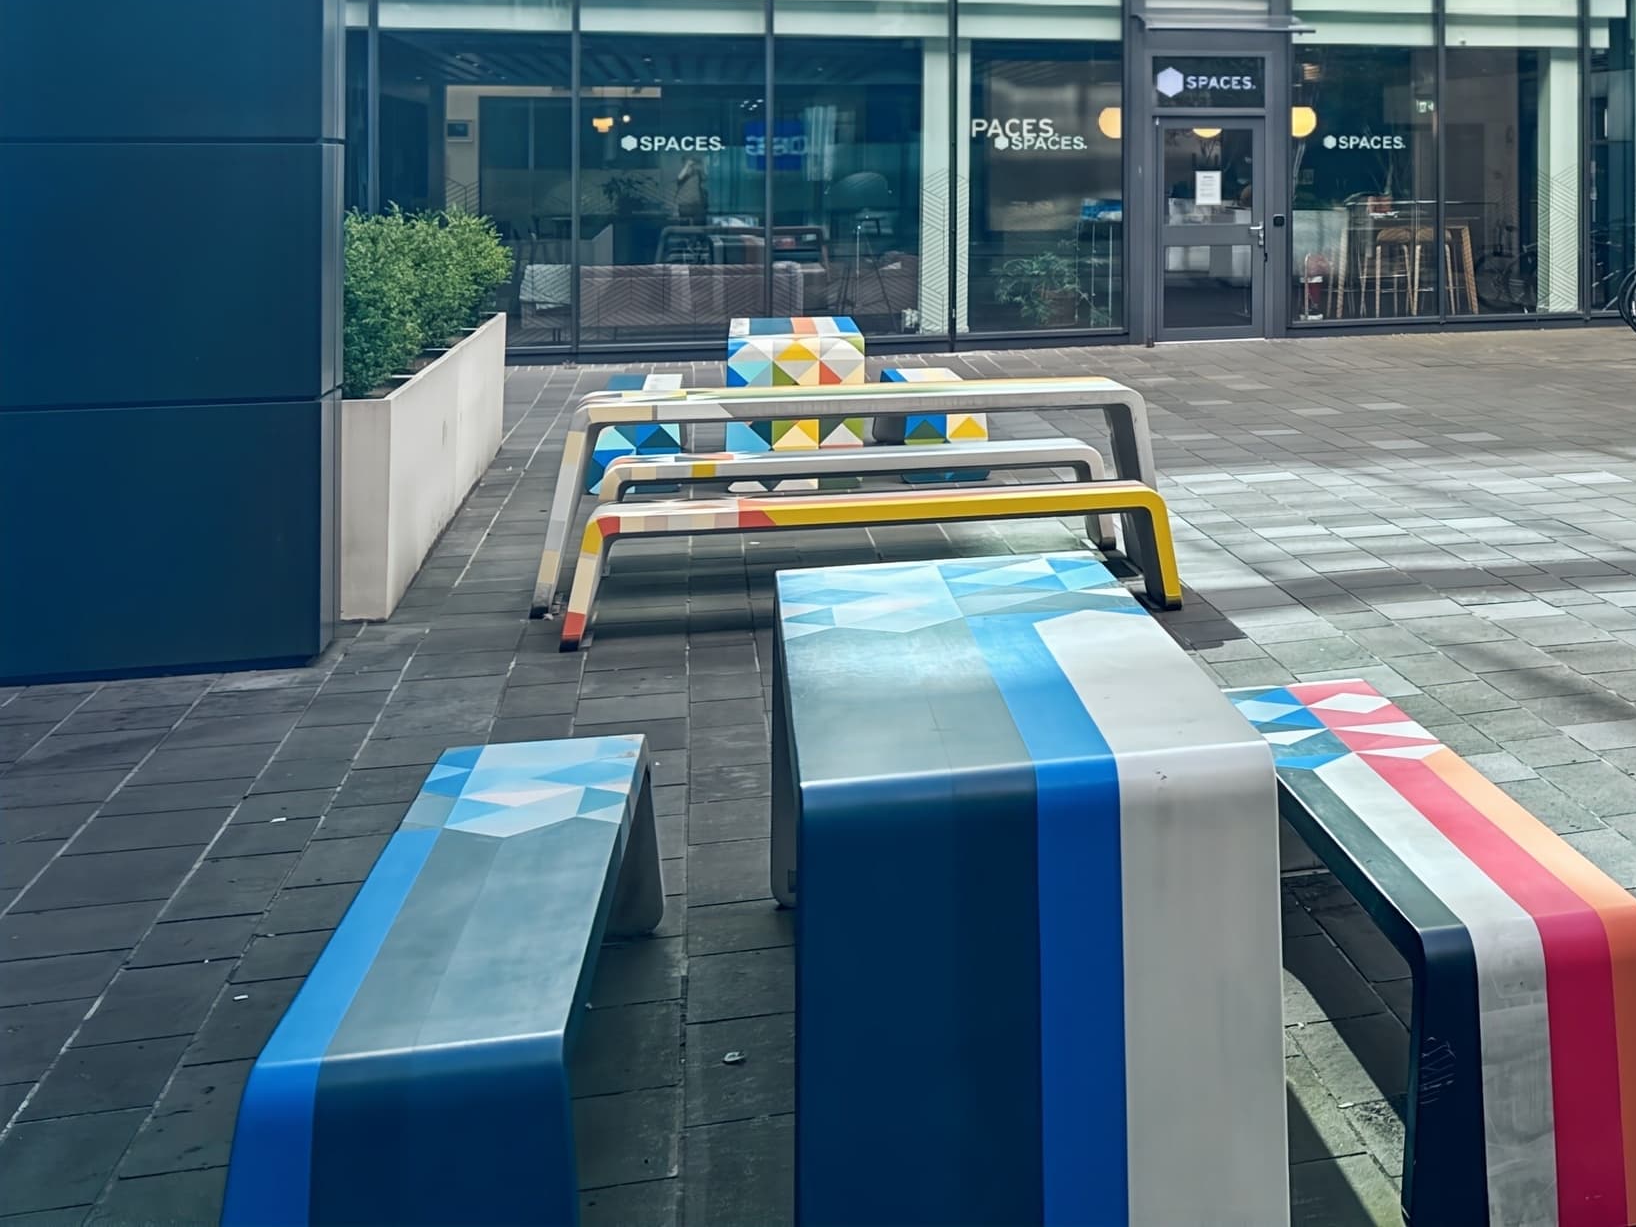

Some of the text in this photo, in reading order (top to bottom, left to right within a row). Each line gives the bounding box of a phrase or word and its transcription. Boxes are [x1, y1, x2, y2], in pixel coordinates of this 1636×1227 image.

[1186, 76, 1256, 89] SPACES.
[640, 136, 726, 151] SPACES.
[1339, 136, 1406, 149] SPACES.
